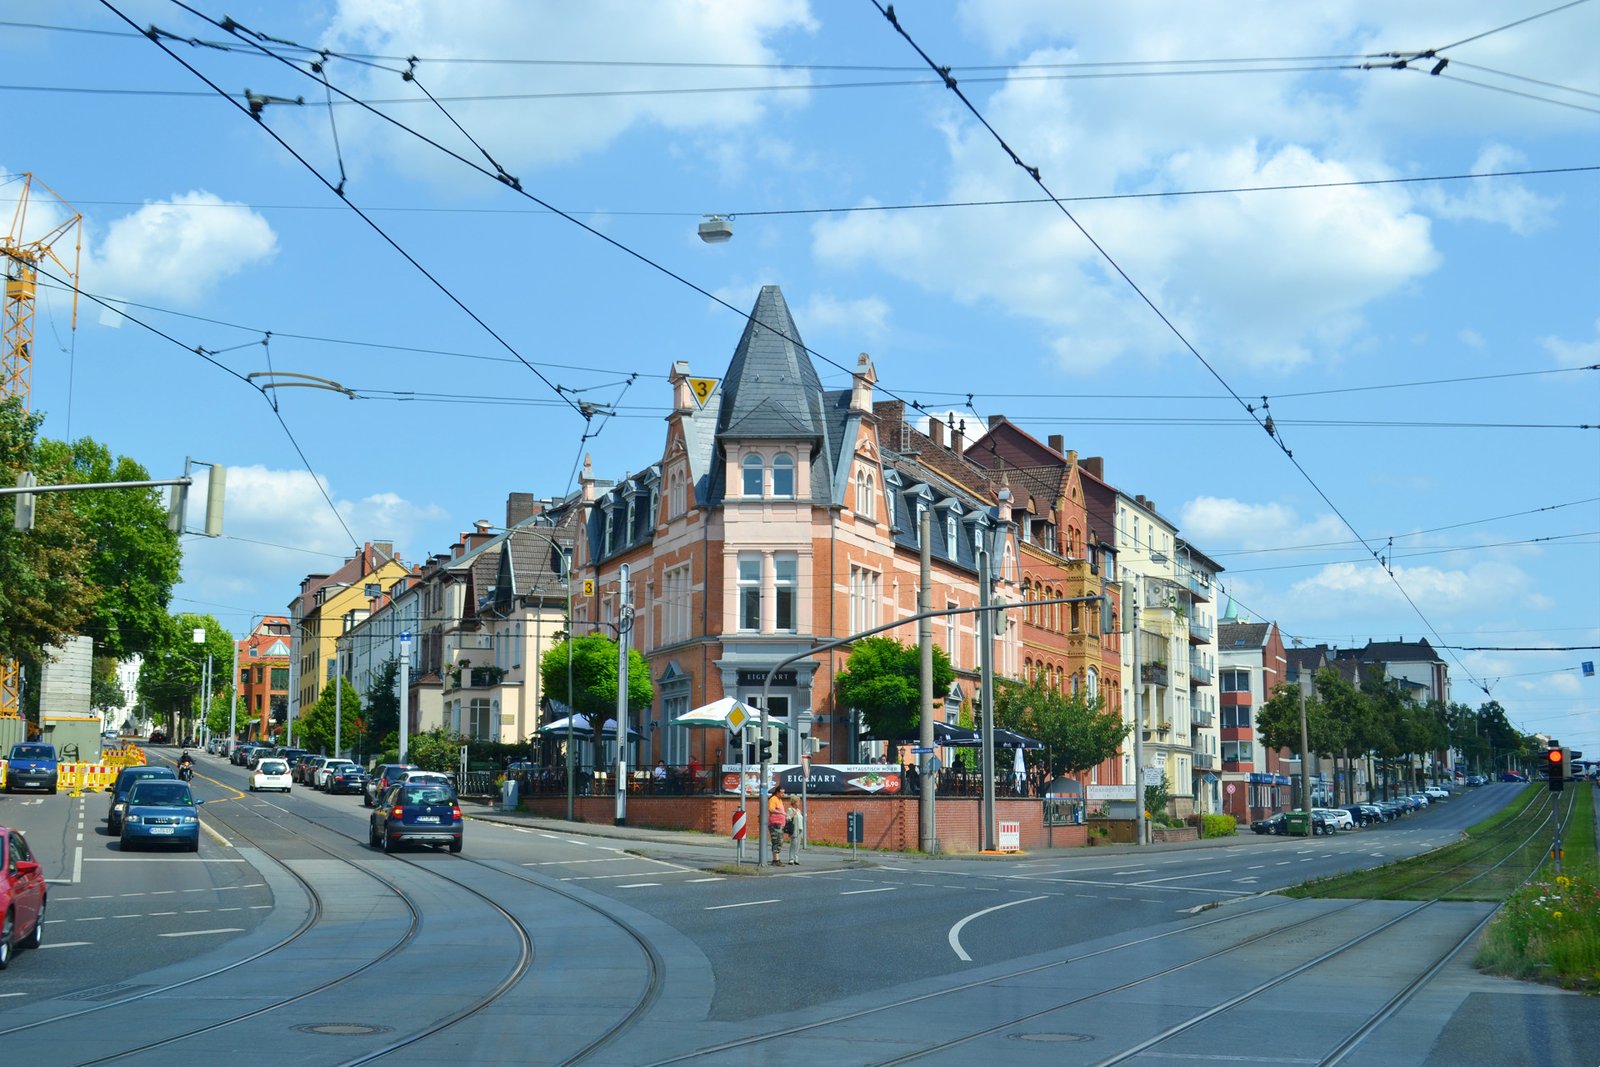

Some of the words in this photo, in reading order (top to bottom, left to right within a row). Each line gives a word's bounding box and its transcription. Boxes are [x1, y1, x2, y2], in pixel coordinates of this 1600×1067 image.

[697, 382, 707, 397] 3
[585, 582, 592, 593] 3
[747, 673, 789, 681] EIGEART
